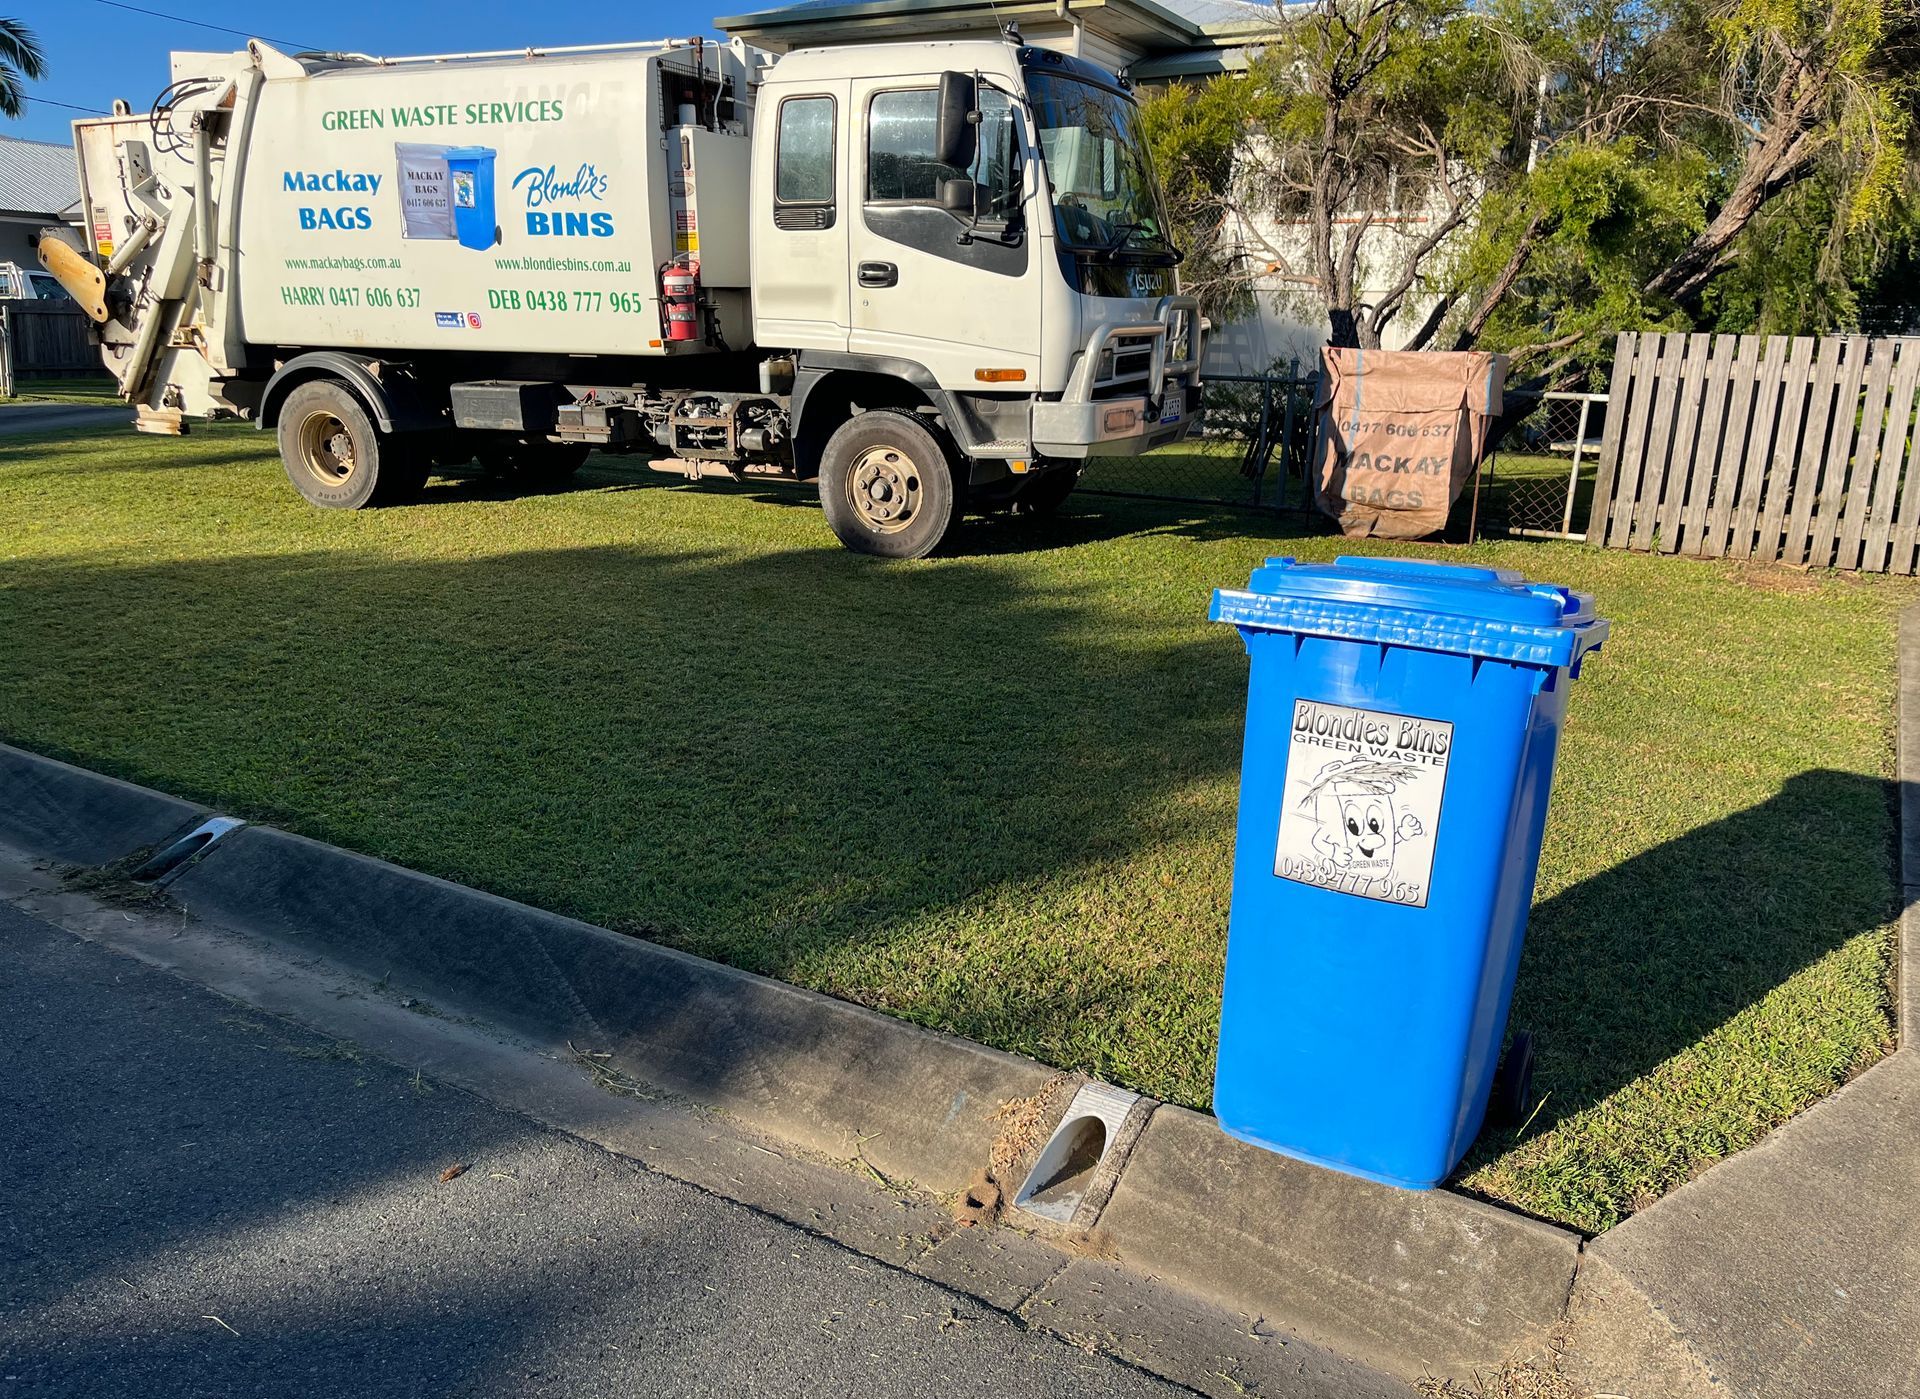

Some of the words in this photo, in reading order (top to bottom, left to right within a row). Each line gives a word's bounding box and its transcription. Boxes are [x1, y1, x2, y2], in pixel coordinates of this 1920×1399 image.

[322, 108, 384, 131] GREEN
[391, 104, 458, 127] WASTE
[465, 99, 564, 124] SERVICES
[283, 169, 383, 196] Mackay
[408, 171, 444, 181] MACKAY
[415, 185, 438, 194] BAGS
[298, 207, 372, 230] BAGS
[525, 212, 615, 237] BINS
[285, 256, 402, 271] www.mackaybags.com.au
[495, 257, 632, 273] www.blondiesbins.com.au
[1135, 273, 1162, 291] ISUZU
[281, 286, 326, 306] HARRY
[329, 287, 360, 307] 0417
[366, 287, 393, 307] 606
[396, 288, 421, 308] 637
[488, 289, 521, 310] DEB
[526, 290, 568, 311] 0438
[573, 291, 602, 312] 777
[609, 292, 642, 313] 965
[1341, 422, 1381, 433] 0417
[1350, 485, 1423, 509] BAGS
[1294, 702, 1390, 746] Blondies
[1396, 717, 1449, 755] Bins
[1293, 734, 1362, 754] GREEN
[1369, 746, 1445, 767] WASTE
[1352, 859, 1371, 869] GREEN
[1371, 858, 1390, 868] WASTE
[1281, 857, 1330, 886] 0438
[1335, 869, 1373, 895] 777
[1379, 878, 1420, 904] 965
